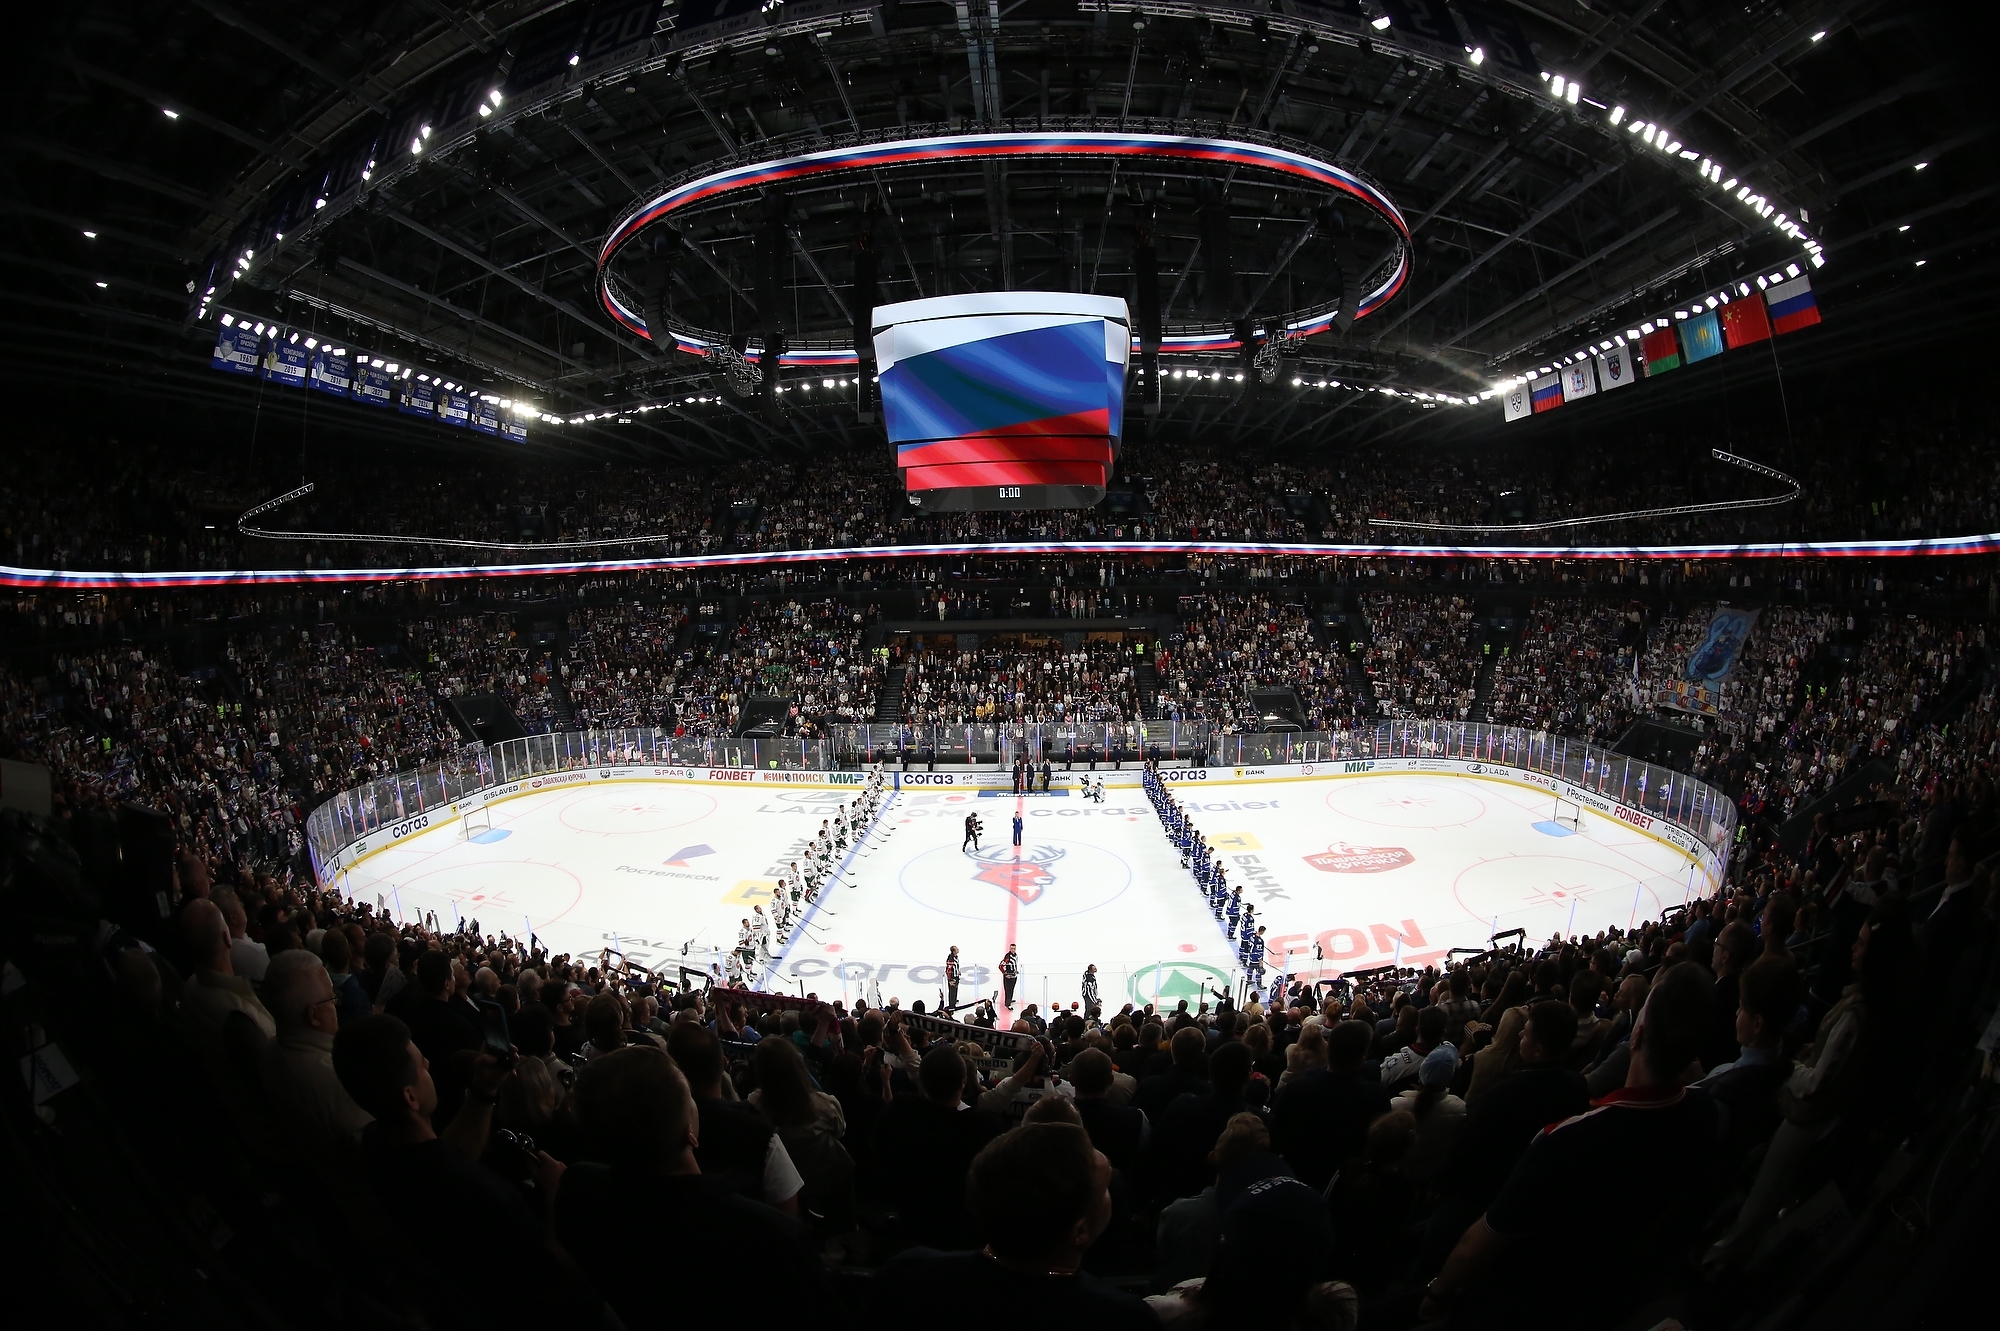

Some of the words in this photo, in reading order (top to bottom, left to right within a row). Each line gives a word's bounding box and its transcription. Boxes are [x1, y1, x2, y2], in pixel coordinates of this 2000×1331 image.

[587, 3, 654, 56] 20
[516, 57, 559, 85] ТРЕНЕР
[284, 365, 297, 375] 2015
[999, 487, 1020, 498] 0:00
[1345, 761, 1375, 773] МИР
[1489, 767, 1510, 778] LADA
[709, 770, 756, 781] FONBET
[829, 773, 865, 784] МИР
[904, 773, 954, 785] согаз
[1523, 773, 1550, 787] SPAR
[483, 784, 519, 801] GISLAVED
[459, 800, 473, 811] БАНК
[1569, 788, 1610, 813] Ростелеком
[756, 804, 839, 815] LAD
[1613, 805, 1654, 830] FONBET
[393, 815, 429, 839] согаз
[1664, 824, 1694, 843] ATRIBUTIKA
[1672, 835, 1686, 848] CLUB
[1312, 850, 1406, 866] ПАВЛОВСКАЯ
[1333, 858, 1400, 869] КУРОЧКА
[615, 864, 721, 882] Ростелеком
[1231, 853, 1291, 903] БАНК
